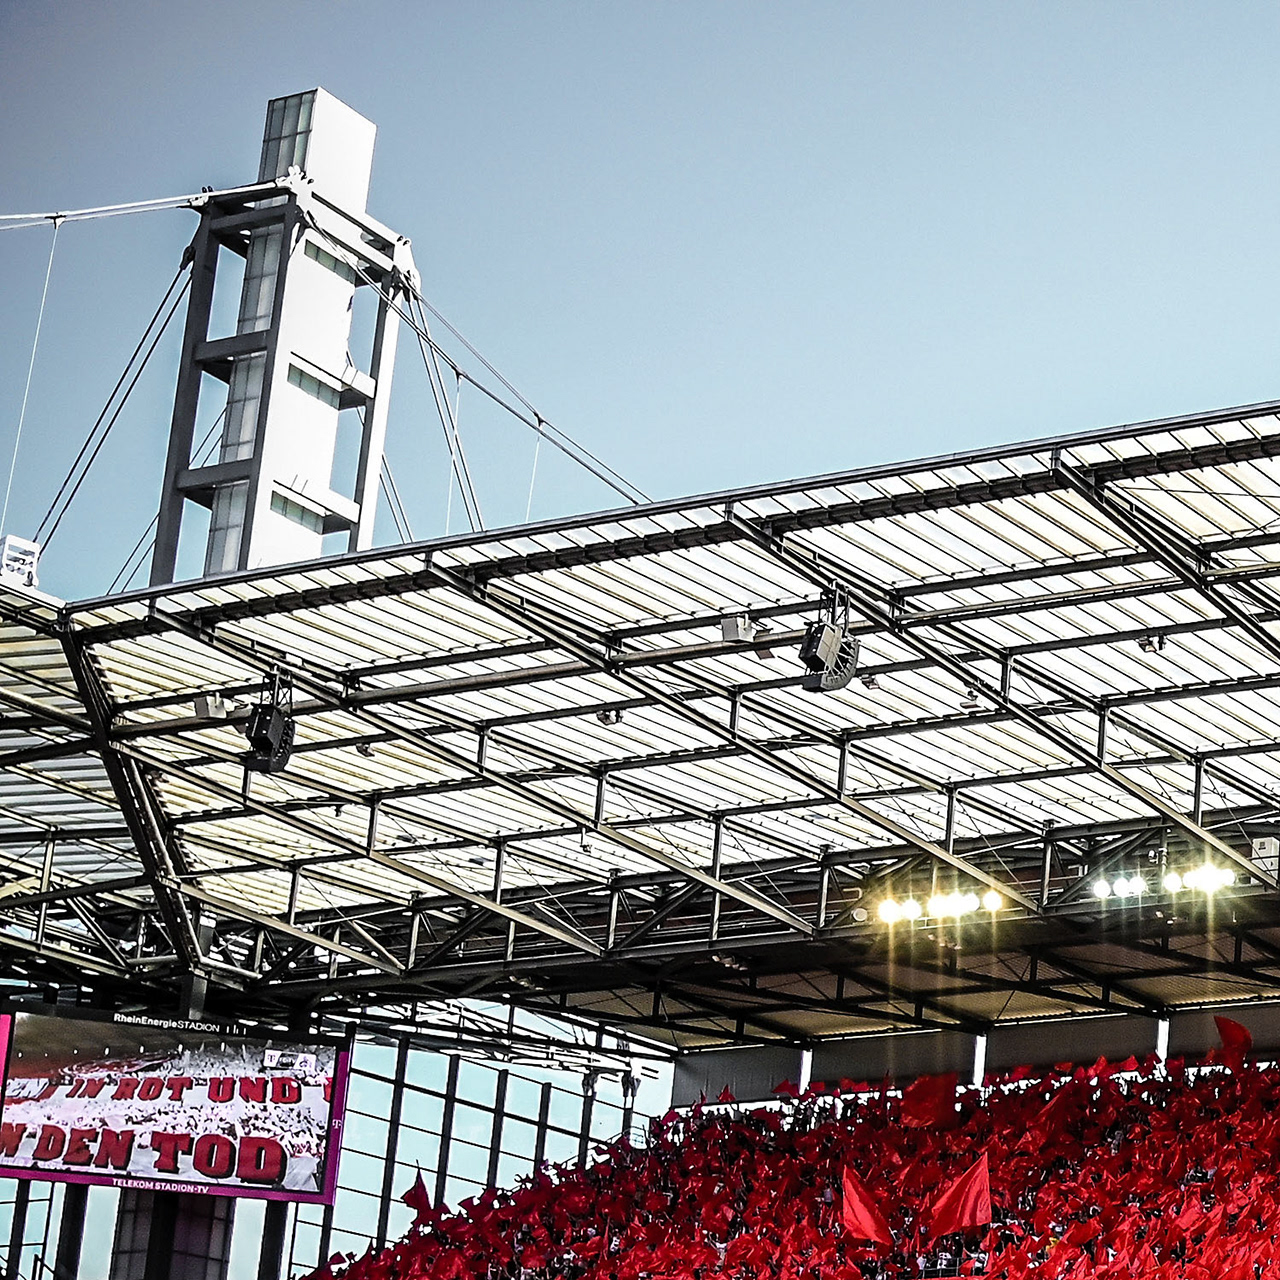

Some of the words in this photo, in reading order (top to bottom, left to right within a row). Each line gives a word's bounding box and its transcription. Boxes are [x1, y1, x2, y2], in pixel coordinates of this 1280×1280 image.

[114, 1013, 220, 1034] RheinEnergieSTADION
[65, 1078, 108, 1099] IN
[112, 1077, 195, 1102] ROT
[207, 1077, 302, 1104] UND
[32, 1124, 135, 1171] DEN
[150, 1133, 286, 1185] TOD
[112, 1178, 153, 1190] TELEKOM
